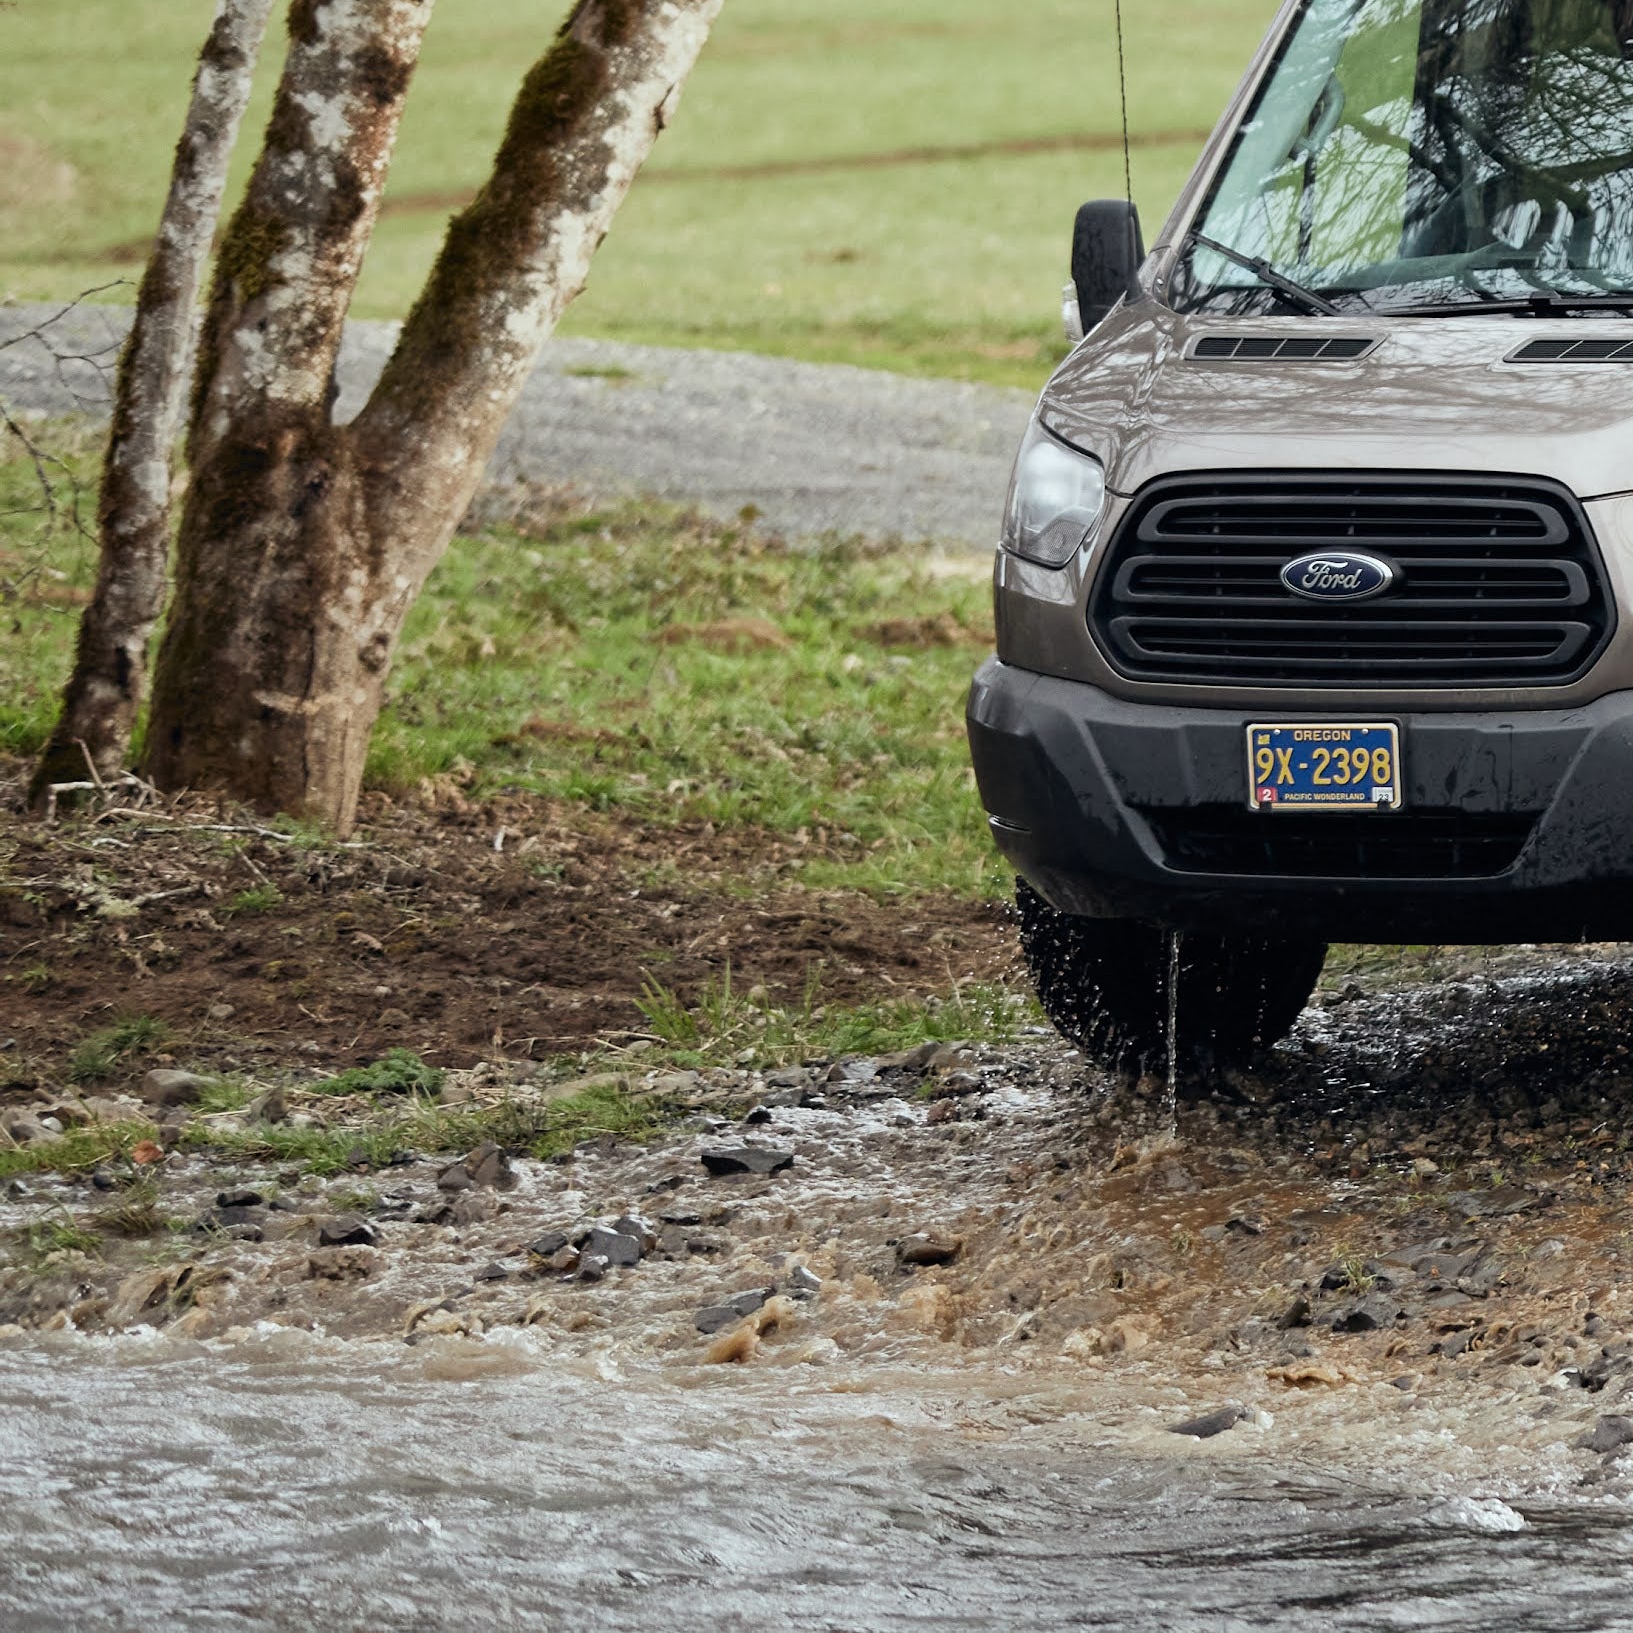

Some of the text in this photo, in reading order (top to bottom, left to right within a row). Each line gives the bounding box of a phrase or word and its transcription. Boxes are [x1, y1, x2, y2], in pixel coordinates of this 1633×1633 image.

[1302, 560, 1363, 589] Ford
[1294, 730, 1351, 741] OREGON
[1256, 747, 1391, 785] 9X-2398
[1262, 788, 1272, 801] 2
